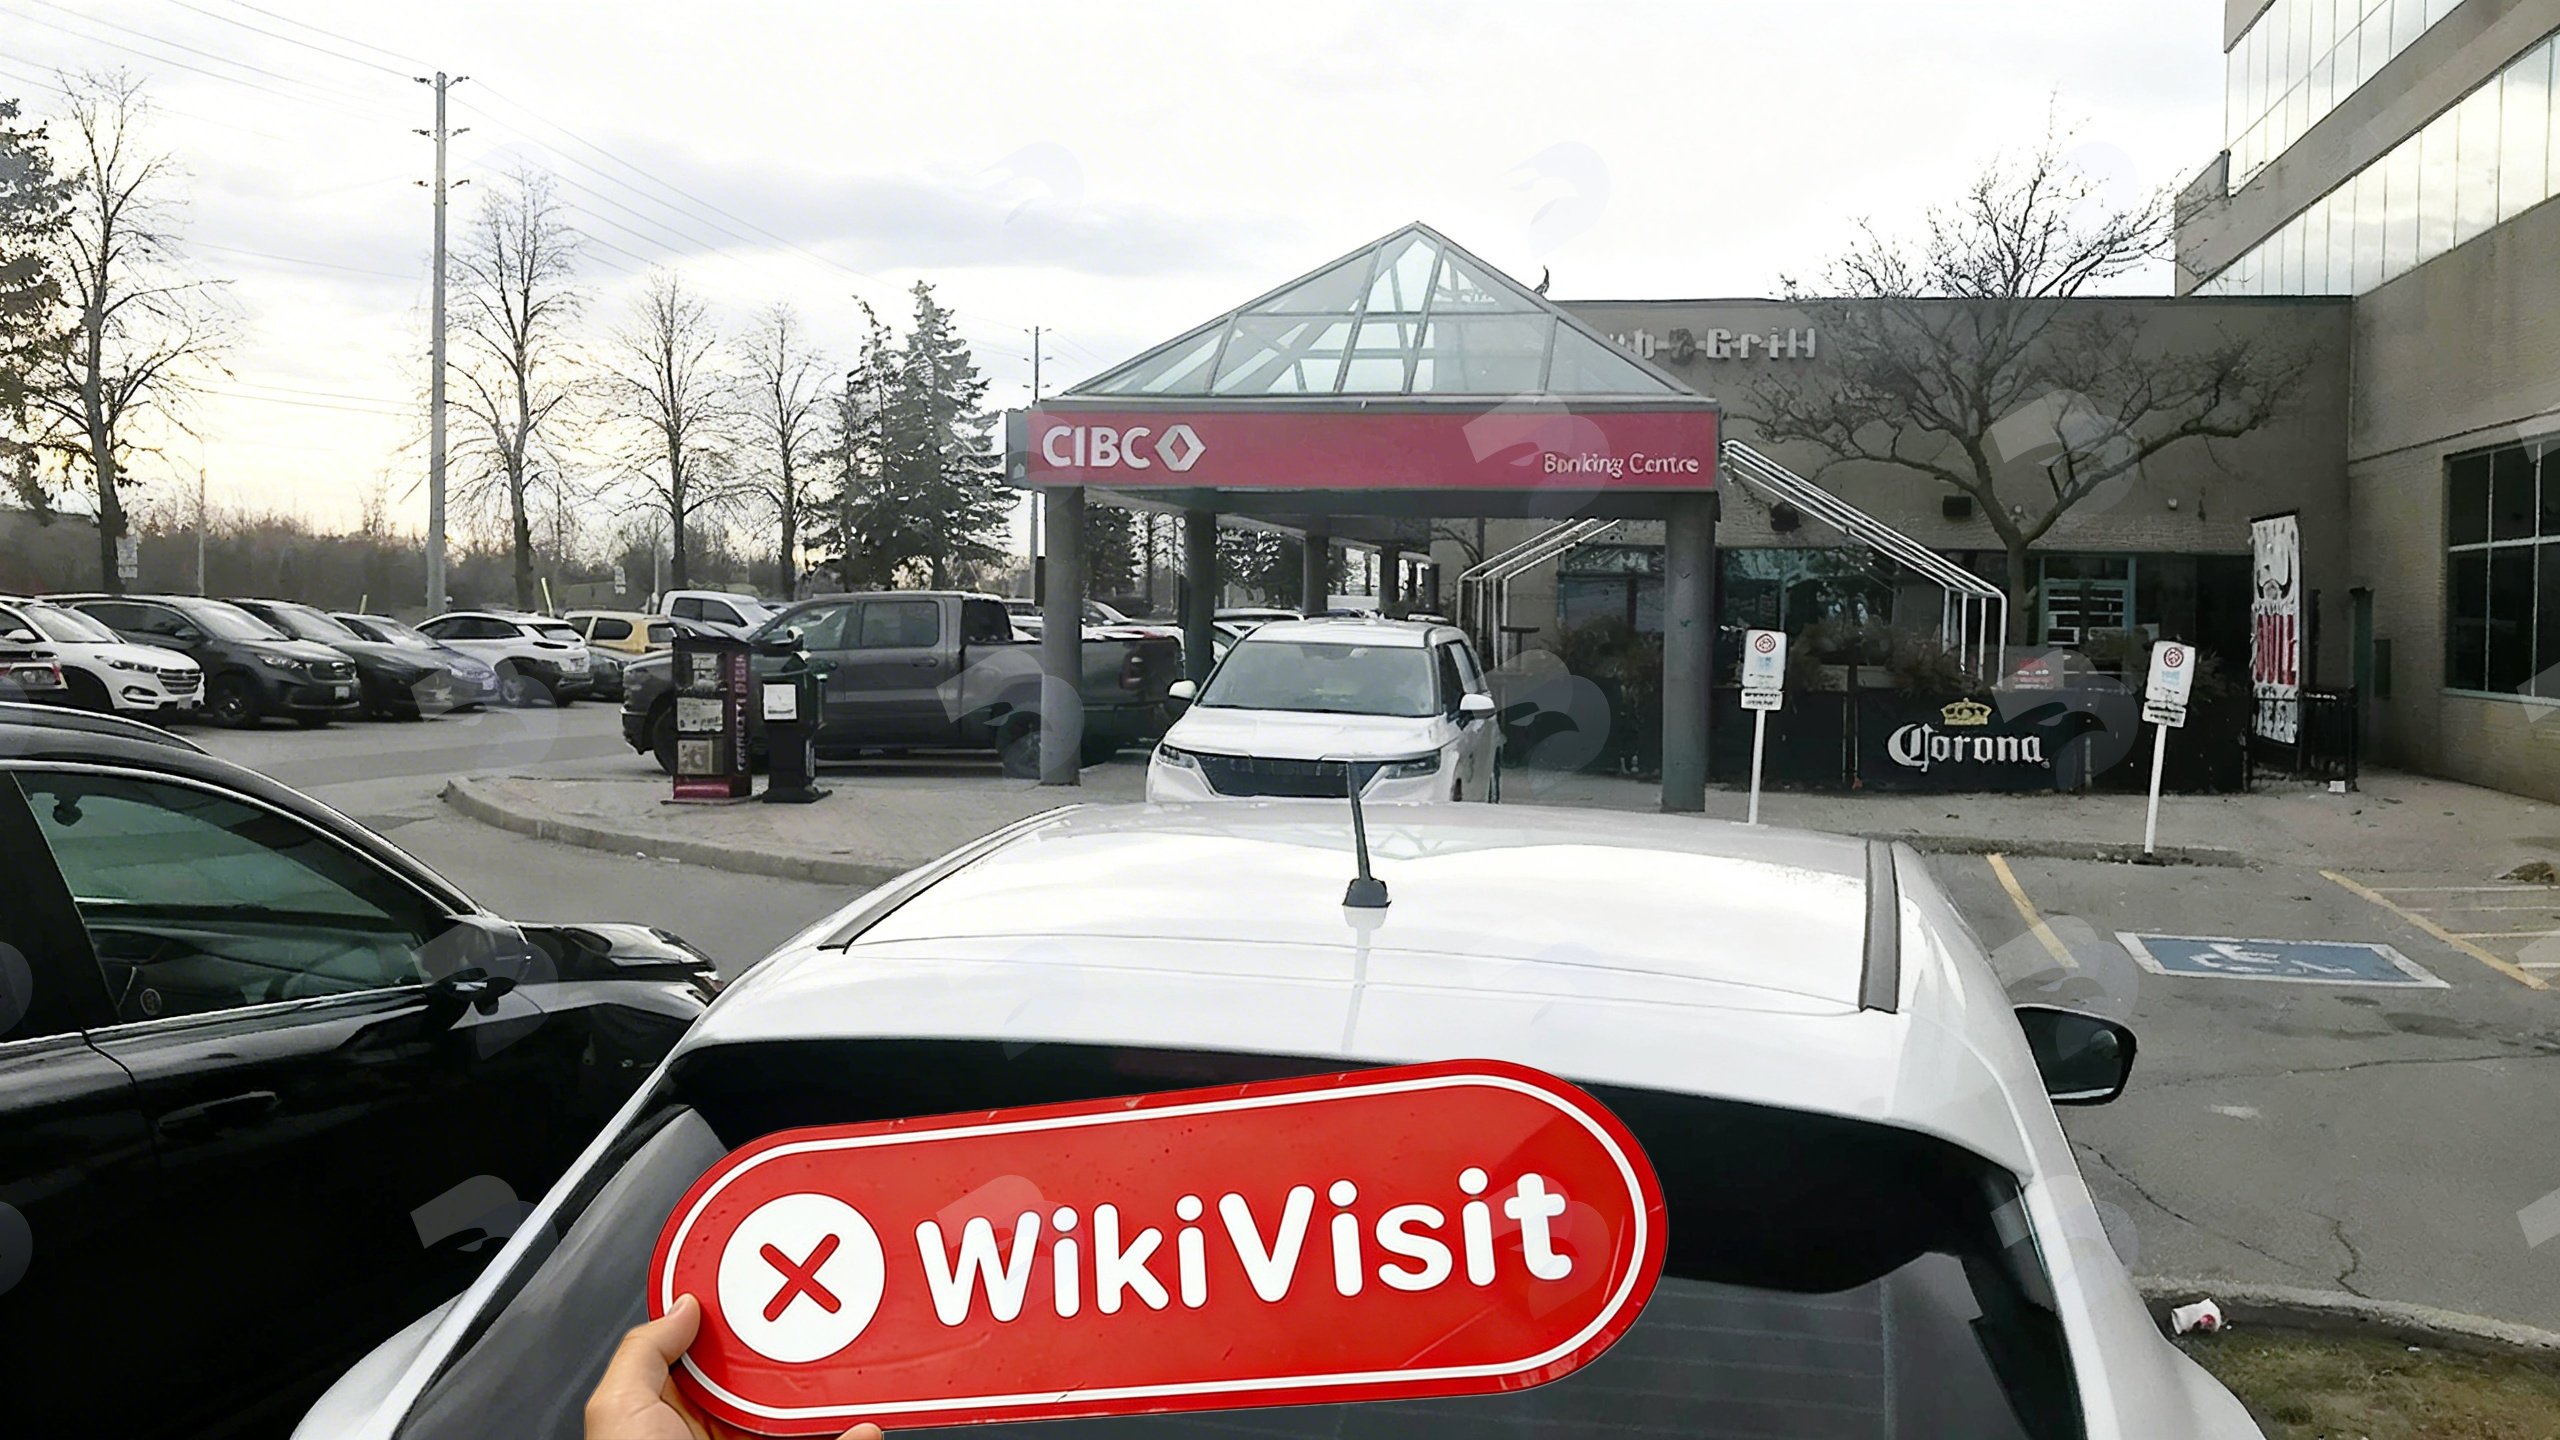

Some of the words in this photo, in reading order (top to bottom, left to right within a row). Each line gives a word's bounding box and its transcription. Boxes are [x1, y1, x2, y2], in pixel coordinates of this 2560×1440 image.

[1706, 326, 1816, 360] Grill
[1042, 425, 1151, 469] CIBC
[1544, 452, 1625, 479] Banking
[1629, 452, 1700, 475] Centre
[1887, 722, 2045, 773] Corona
[914, 1166, 1574, 1327] WikiVisit
